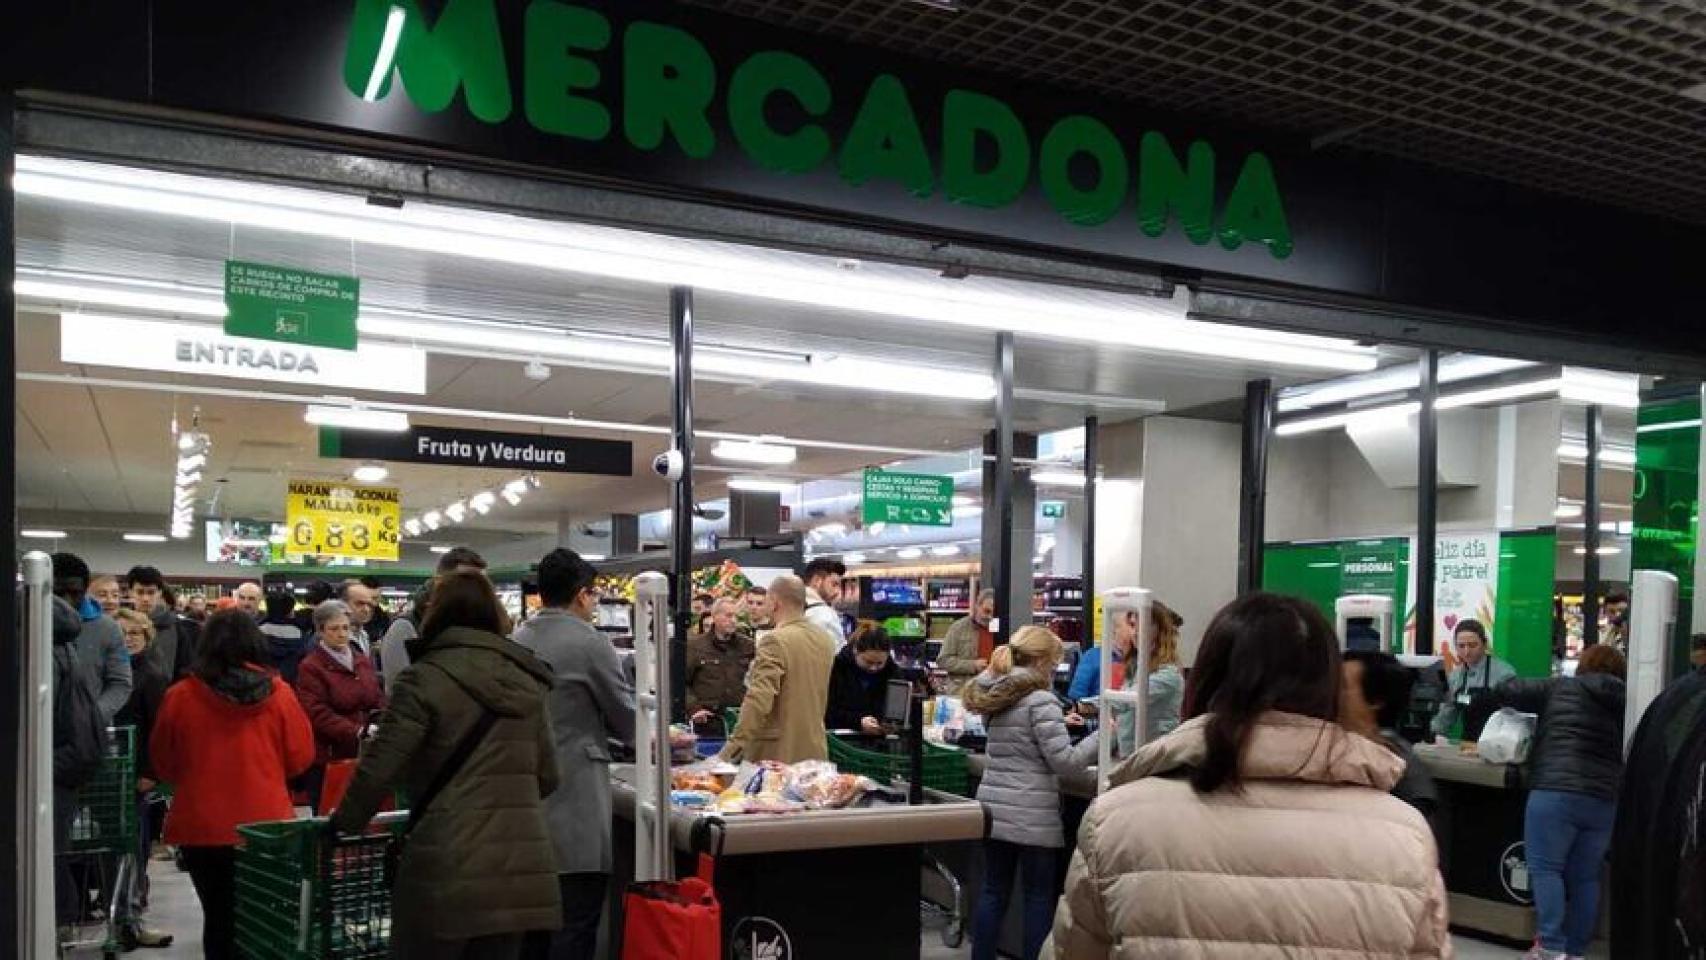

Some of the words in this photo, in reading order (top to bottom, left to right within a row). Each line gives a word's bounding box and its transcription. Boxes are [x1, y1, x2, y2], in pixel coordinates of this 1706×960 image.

[343, 0, 1294, 260] MERCADONA
[230, 265, 244, 275] SE
[286, 274, 303, 284] NO
[306, 276, 339, 289] SACAR
[230, 276, 275, 289] CARROS
[277, 282, 291, 292] DE
[294, 284, 338, 298] COMPRA
[341, 291, 355, 301] DE
[230, 285, 256, 296] ESTE
[258, 289, 305, 303] RECINTO
[176, 340, 319, 374] ENTRADA
[417, 436, 472, 458] Fruta
[476, 443, 487, 463] y
[490, 442, 566, 464] Verdura
[304, 498, 353, 513] MALLA
[1345, 561, 1394, 573] PERSONAL
[1441, 562, 1489, 584] padre!
